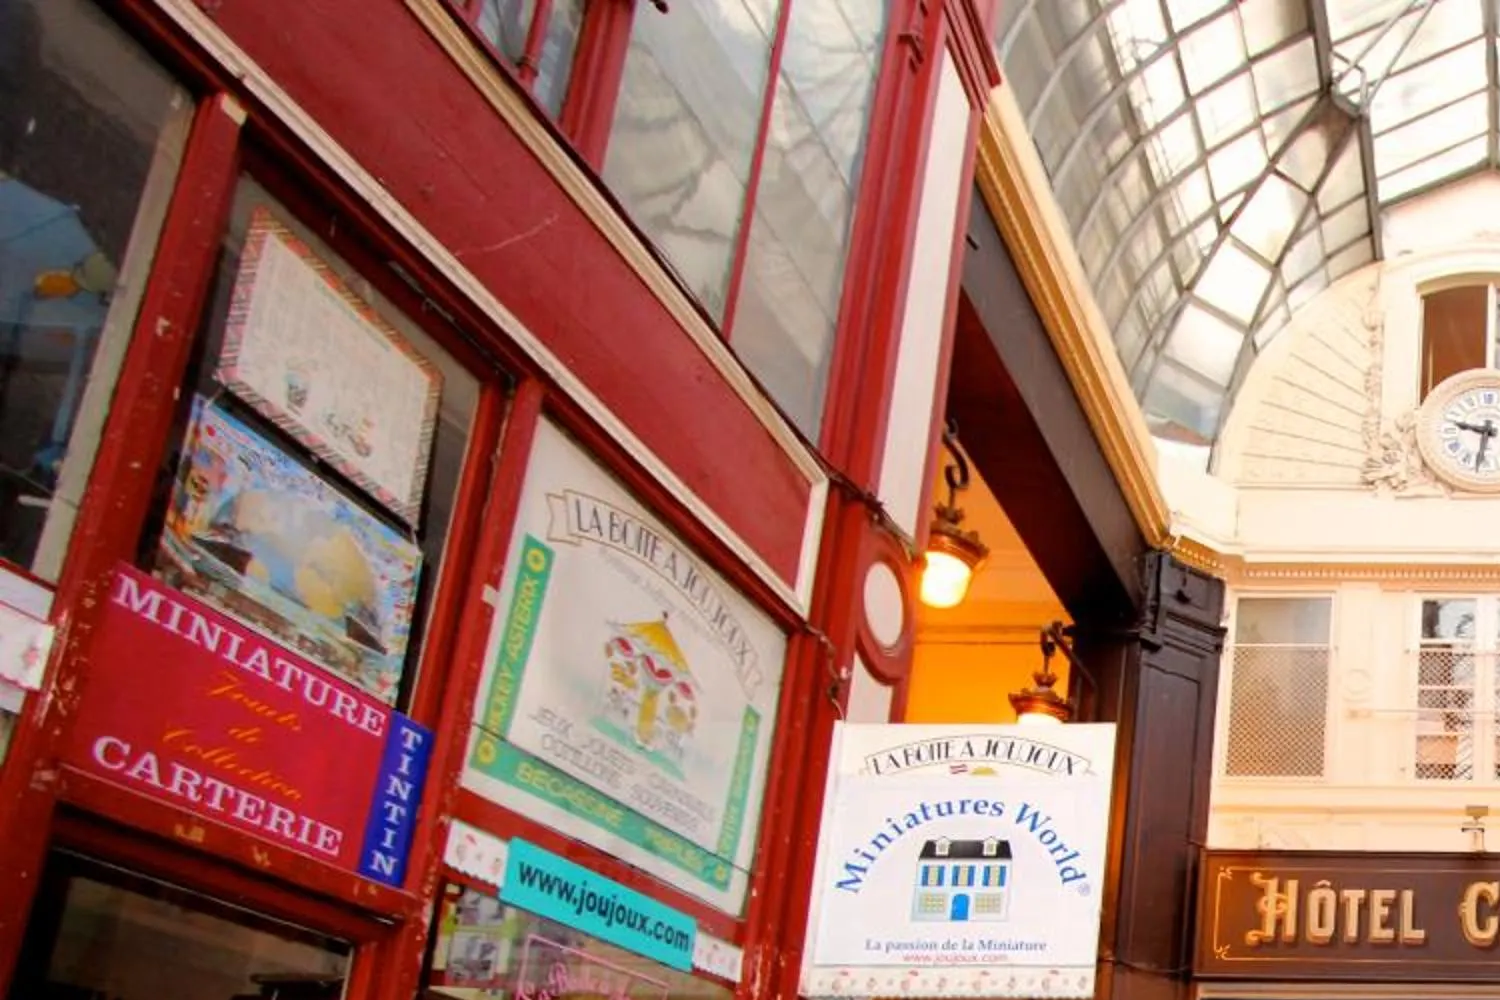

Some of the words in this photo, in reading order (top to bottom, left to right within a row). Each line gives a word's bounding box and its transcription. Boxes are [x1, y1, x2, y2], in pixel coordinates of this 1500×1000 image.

[575, 499, 603, 537] LA
[112, 573, 387, 737] MINIATURE
[92, 735, 344, 857] CARTERIE
[371, 726, 424, 877] TINTIN
[872, 753, 901, 776] LA
[960, 738, 975, 756] A
[835, 798, 1005, 894] Miniatures
[1014, 803, 1087, 885] World
[517, 860, 690, 952] www.joujoux.com
[865, 938, 881, 951] La
[885, 938, 938, 954] passion
[941, 937, 959, 951] de
[962, 937, 975, 951] la
[978, 937, 1047, 951] Miniature
[1245, 872, 1428, 946] HÔTEL
